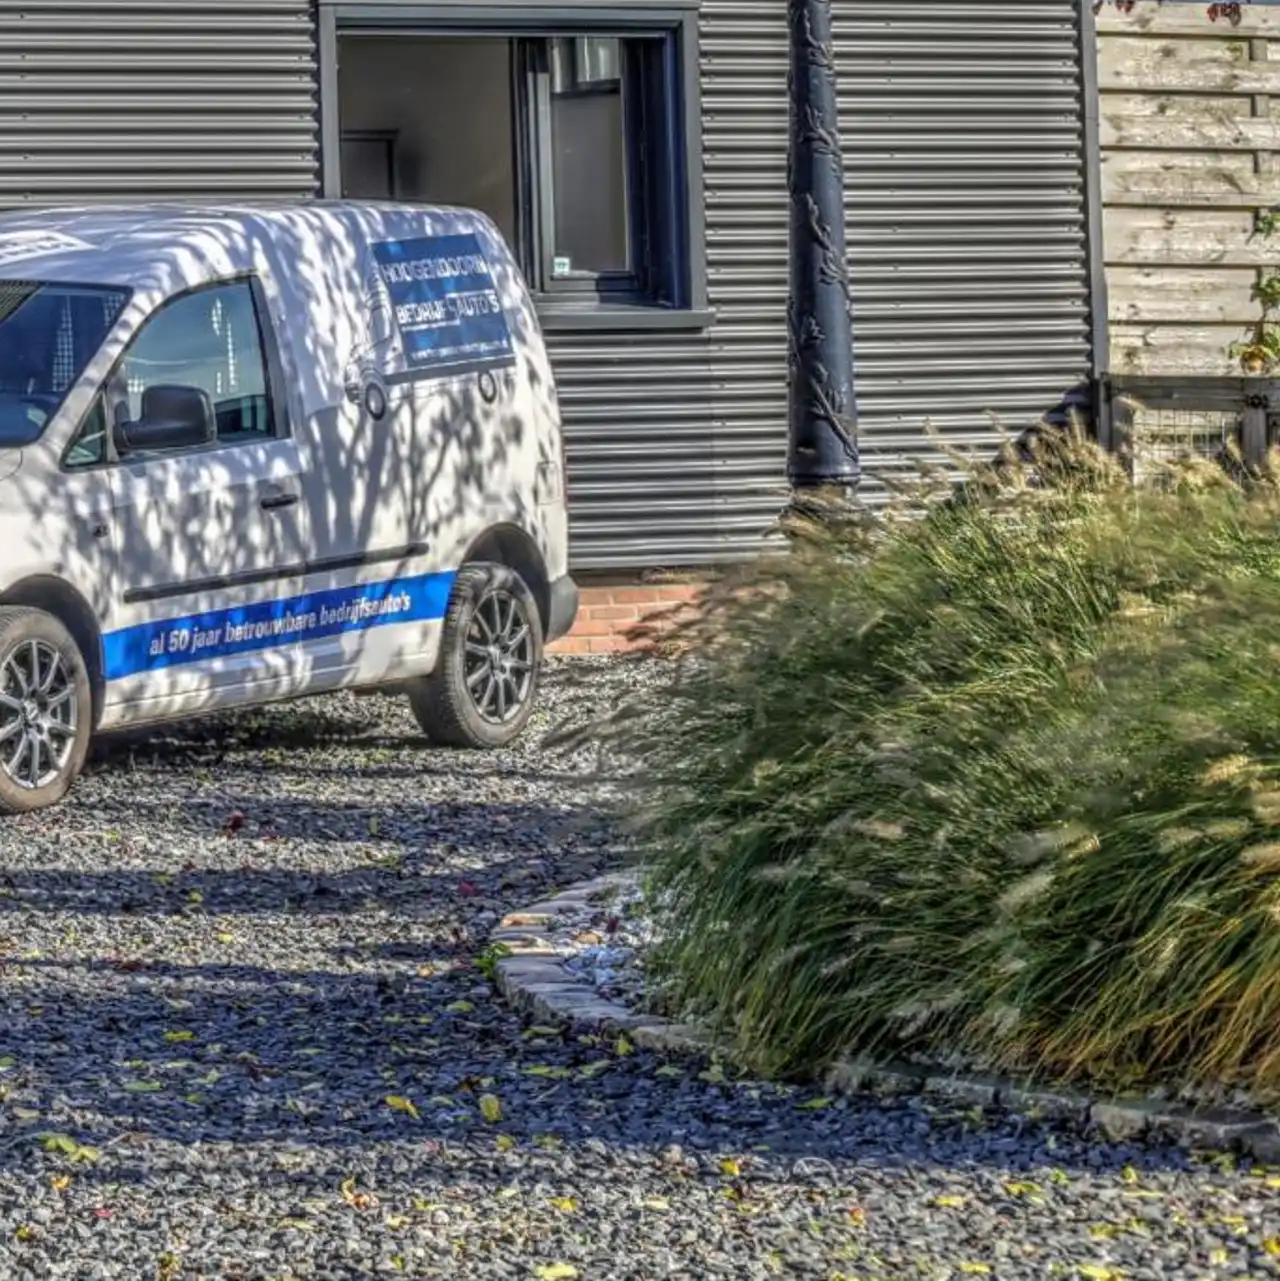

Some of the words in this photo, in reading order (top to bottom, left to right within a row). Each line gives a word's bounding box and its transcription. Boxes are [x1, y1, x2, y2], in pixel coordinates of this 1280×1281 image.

[149, 632, 164, 656] al
[169, 628, 189, 653] 50
[191, 625, 221, 653] jaar
[225, 610, 316, 644] betrouwbare
[320, 589, 412, 625] bedrijfsauto's
